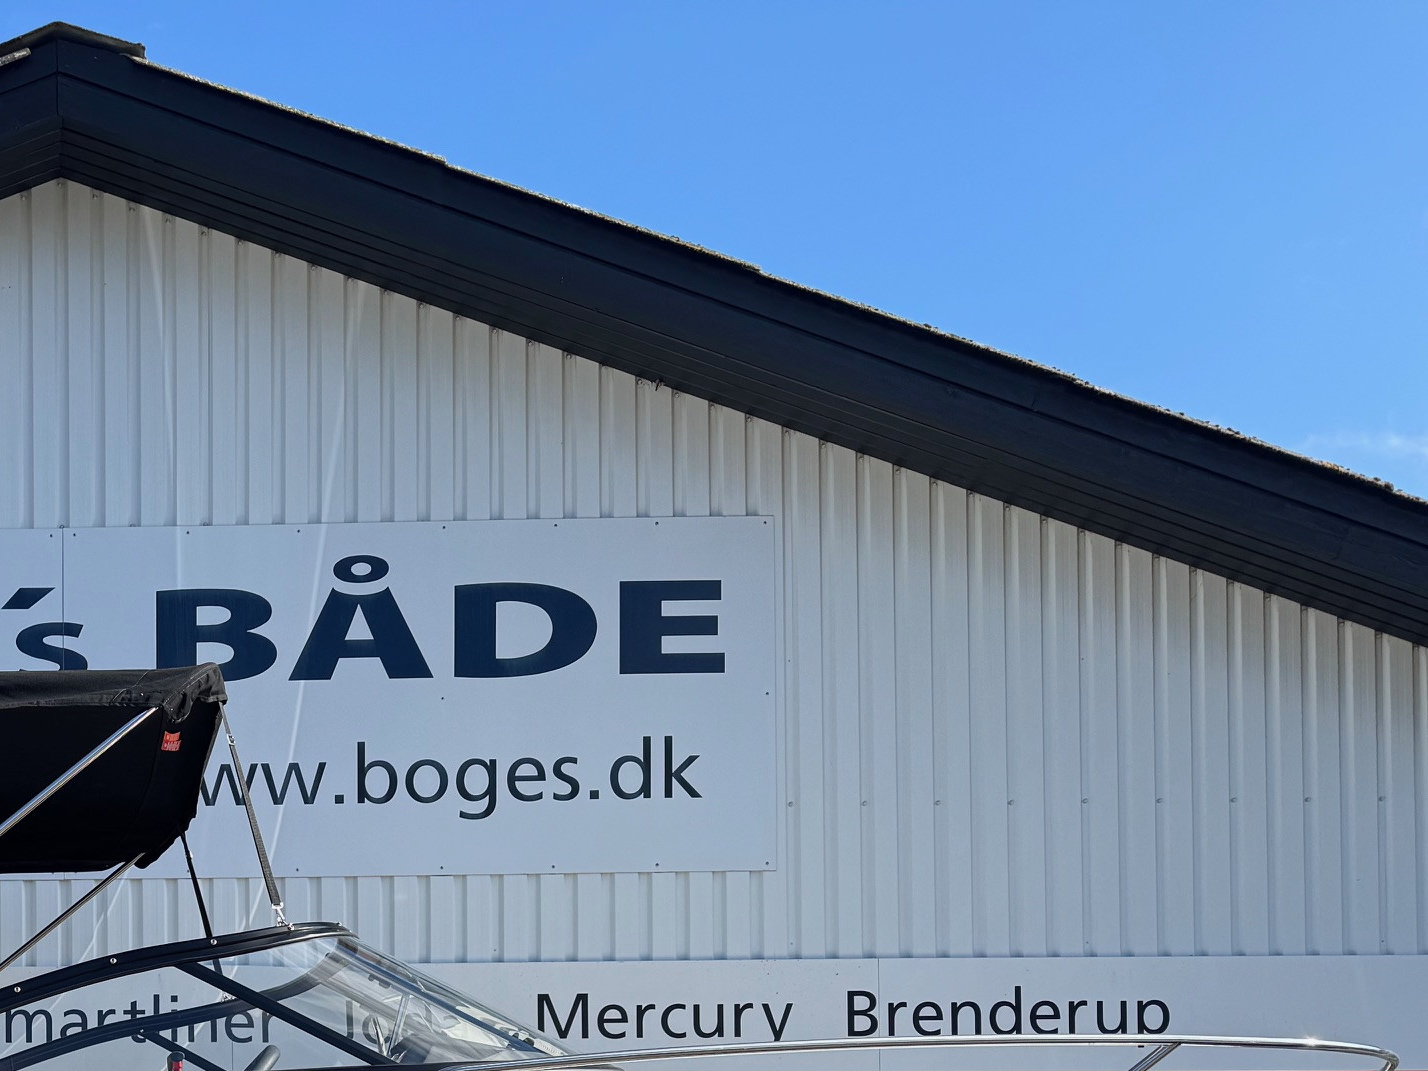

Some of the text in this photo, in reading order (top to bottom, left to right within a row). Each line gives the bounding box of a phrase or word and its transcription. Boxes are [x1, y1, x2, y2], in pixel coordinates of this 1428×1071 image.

[155, 554, 726, 682] BÅDE
[200, 736, 703, 820] ww.boges.dk
[537, 993, 794, 1042] Mercury
[846, 986, 1171, 1047] Brenderup
